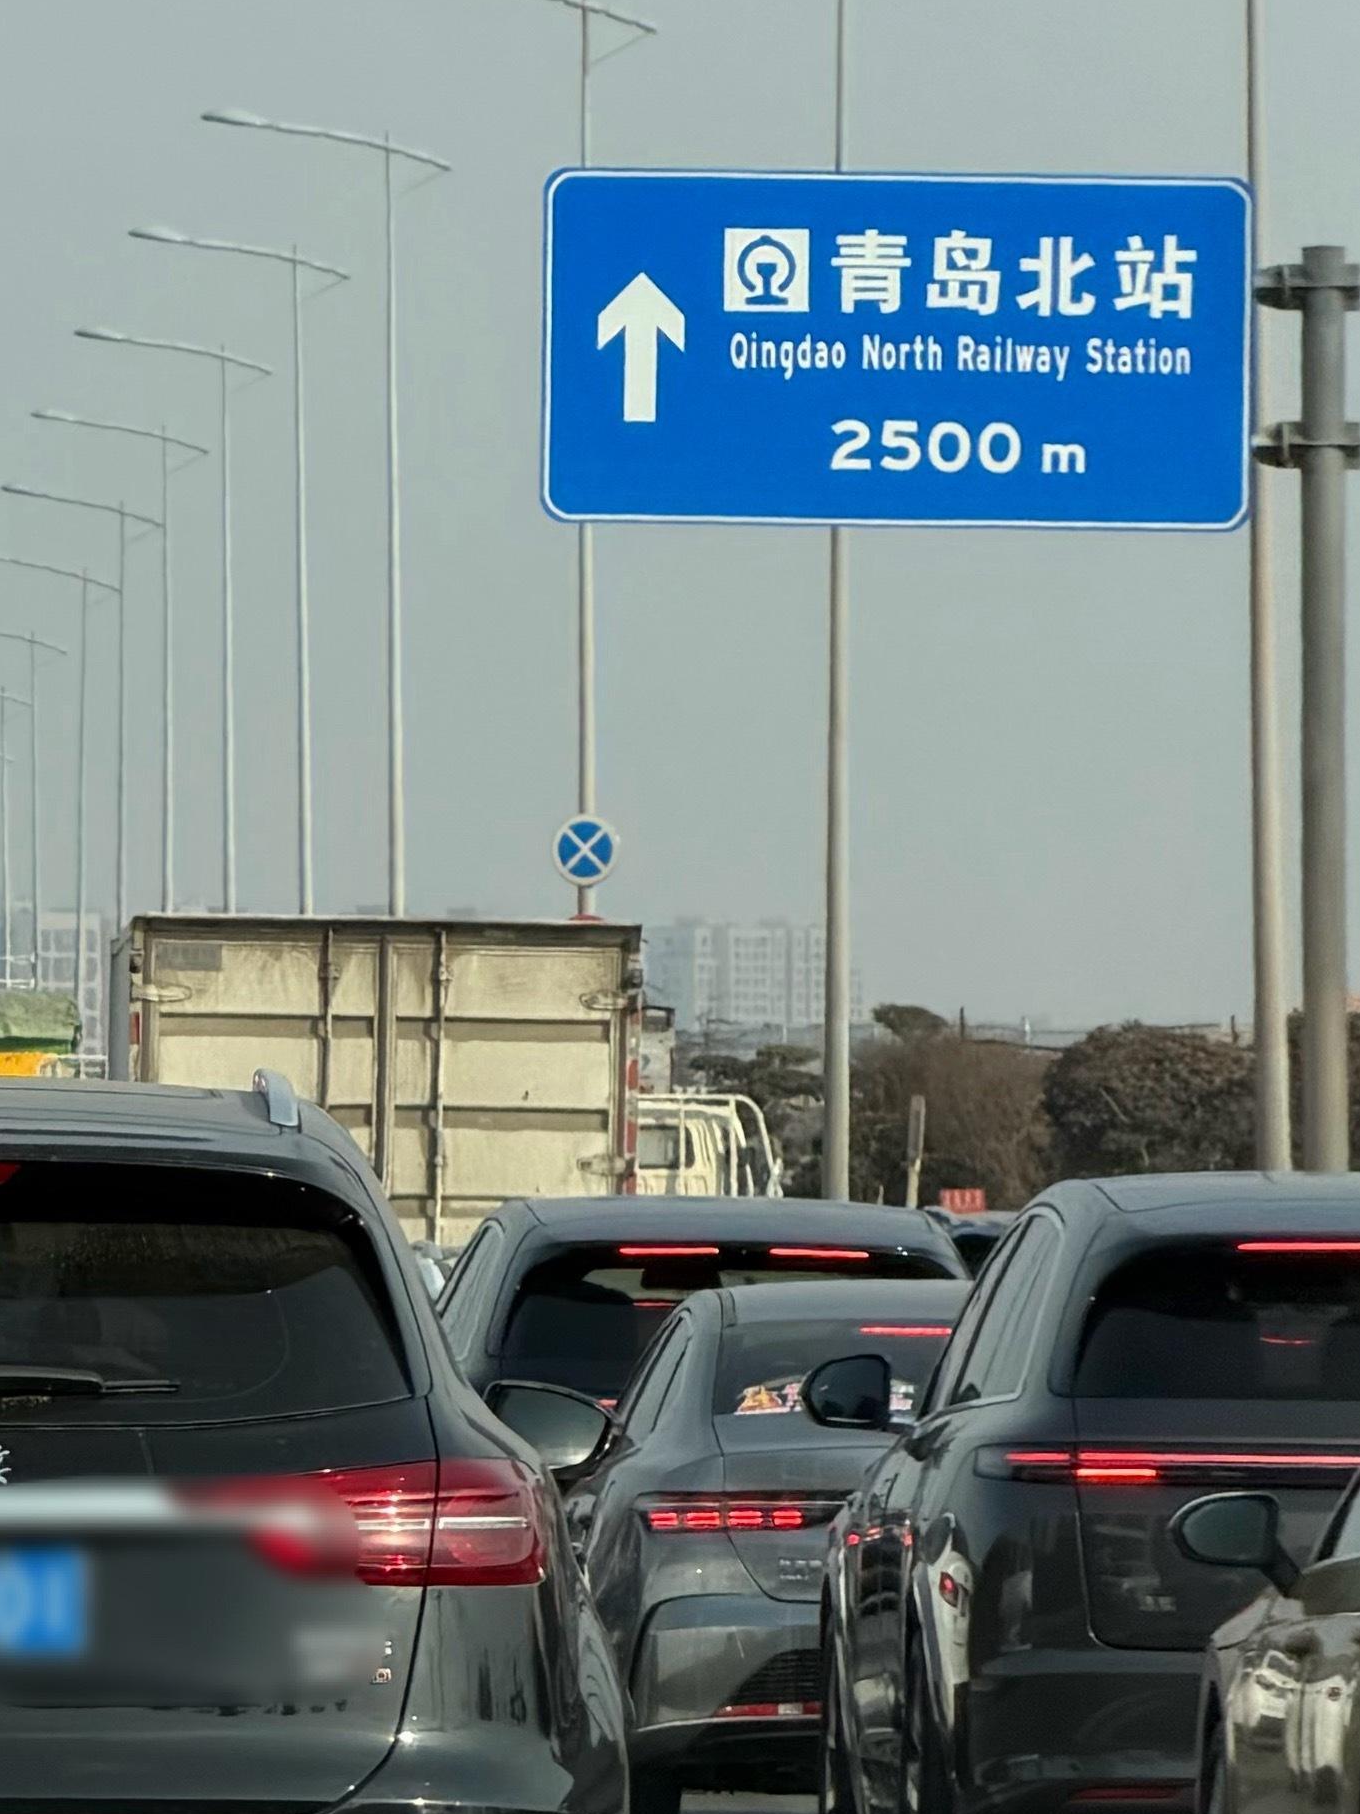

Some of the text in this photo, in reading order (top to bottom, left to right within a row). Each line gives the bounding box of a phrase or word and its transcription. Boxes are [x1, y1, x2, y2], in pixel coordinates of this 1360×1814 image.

[830, 228, 1198, 319] 青岛北站
[729, 331, 1191, 382] Qingdao North Railway Station
[829, 418, 1086, 474] 2500 m
